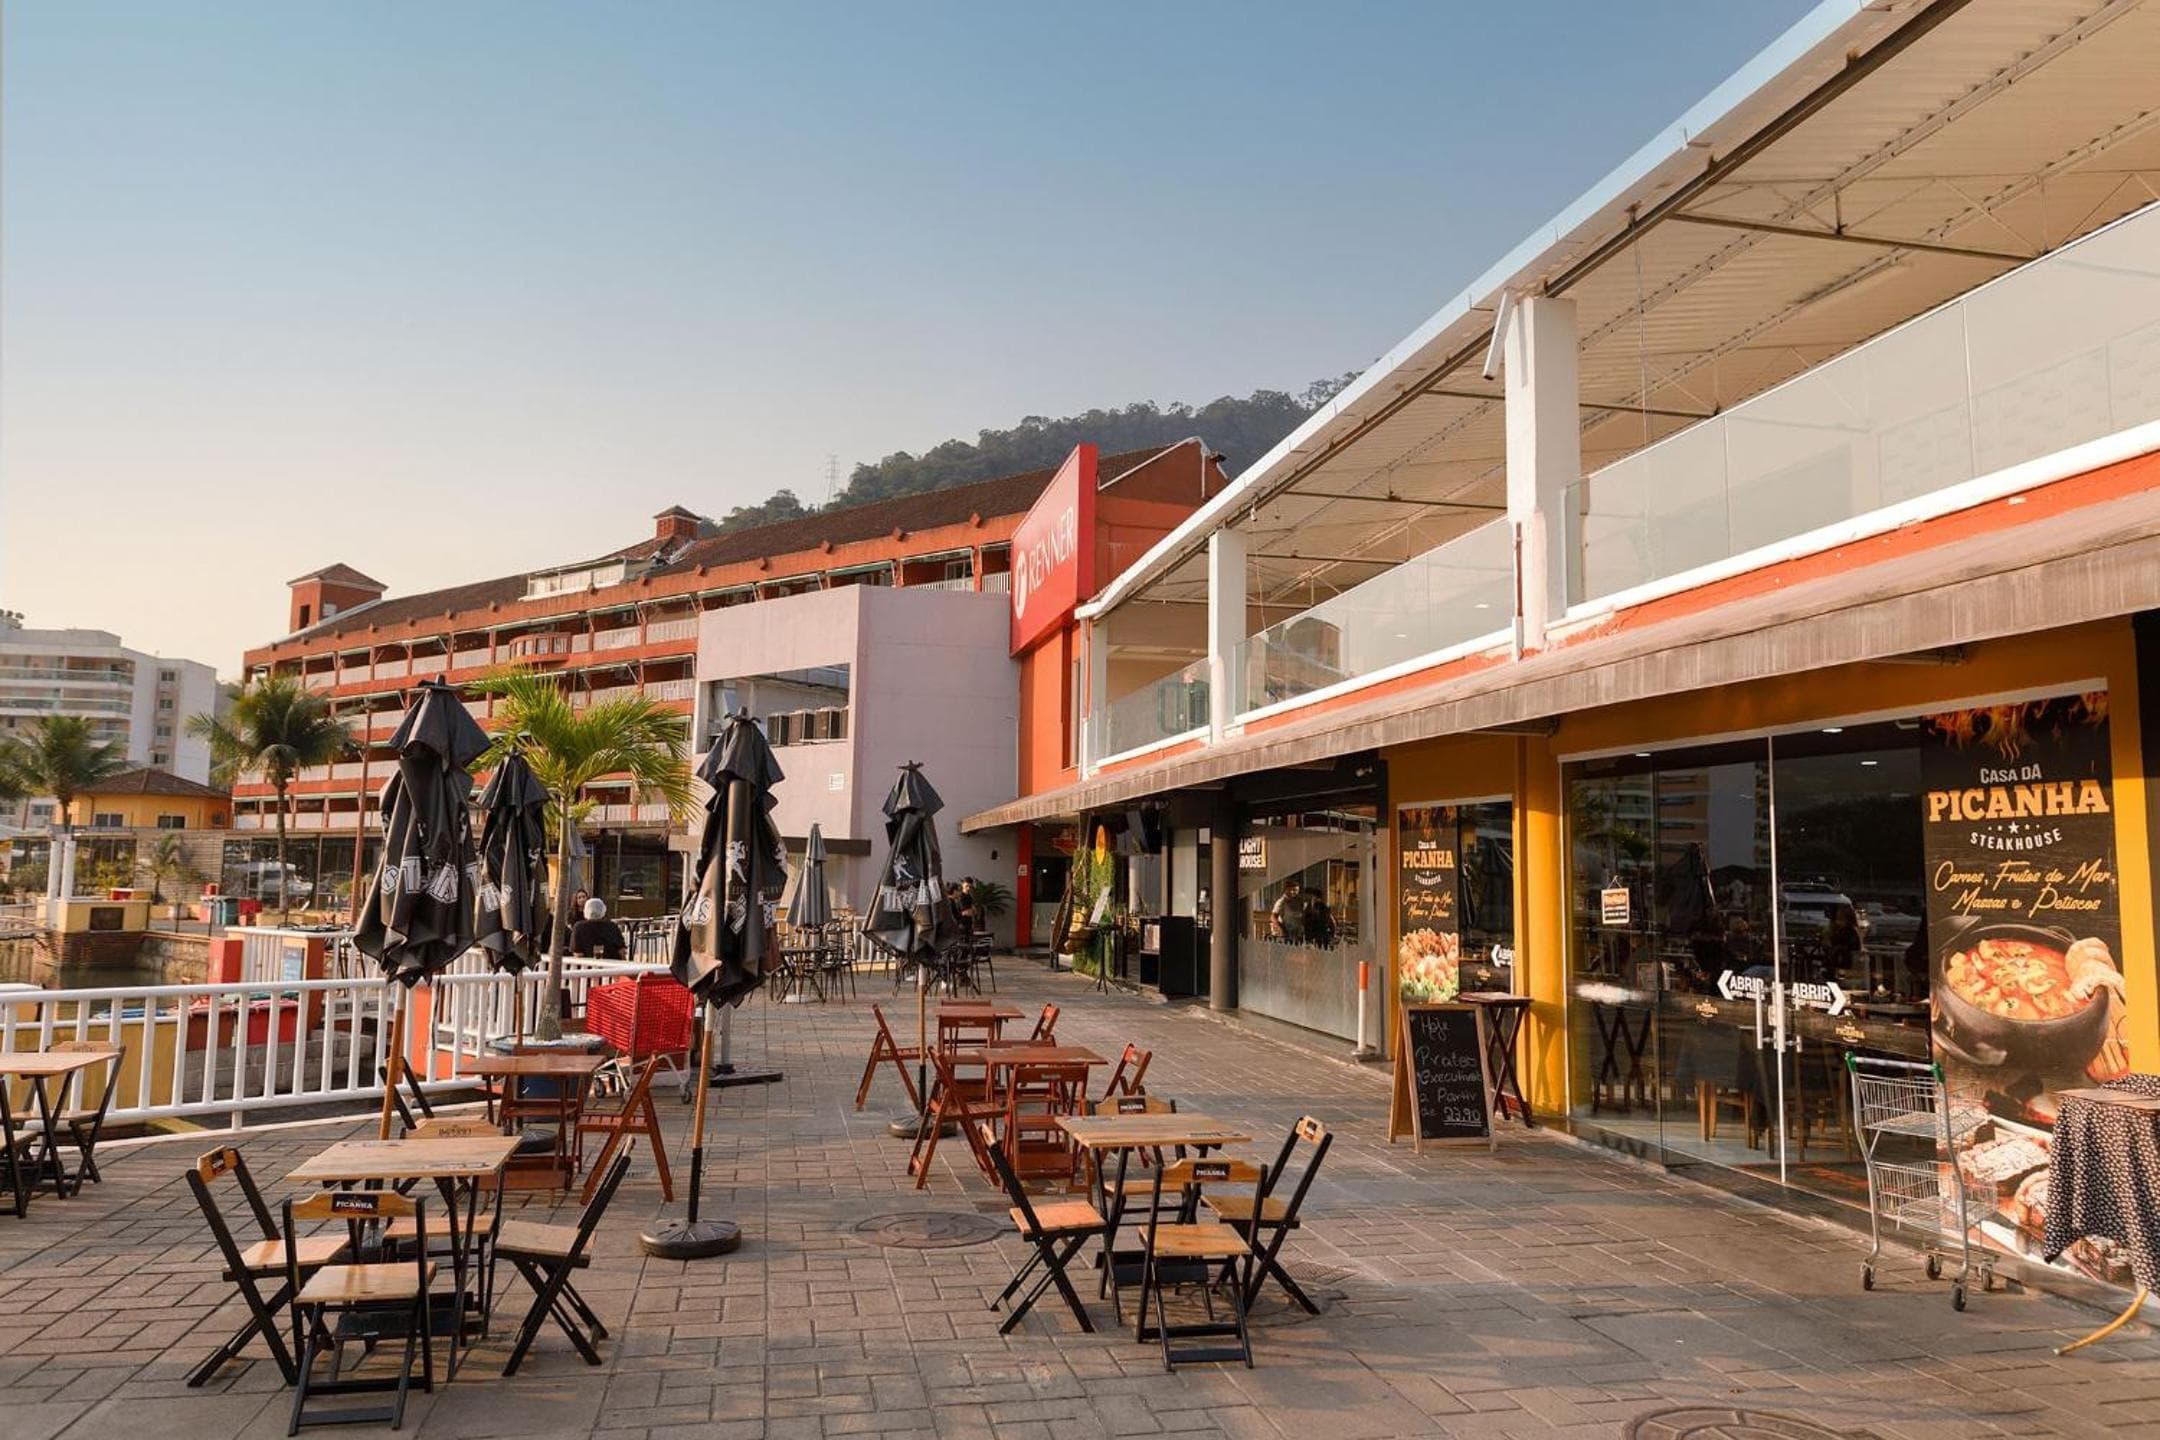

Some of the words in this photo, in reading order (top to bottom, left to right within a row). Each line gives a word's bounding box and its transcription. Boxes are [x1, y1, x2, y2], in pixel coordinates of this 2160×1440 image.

[1029, 506, 1074, 595] RENNER
[1980, 767, 2018, 784] CASA
[2021, 763, 2042, 780] DA
[1928, 779, 2110, 822] PICANHA
[1970, 828, 2063, 851] STEAKHOUSE
[1403, 850, 1455, 868] PICANHA
[1993, 859, 2039, 891] Frutos
[1952, 886, 2006, 917] Massas
[2011, 901, 2022, 909] e
[2028, 883, 2101, 919] Petiscos
[1791, 981, 1831, 1002] ABRIR
[336, 1201, 374, 1209] PICANHA
